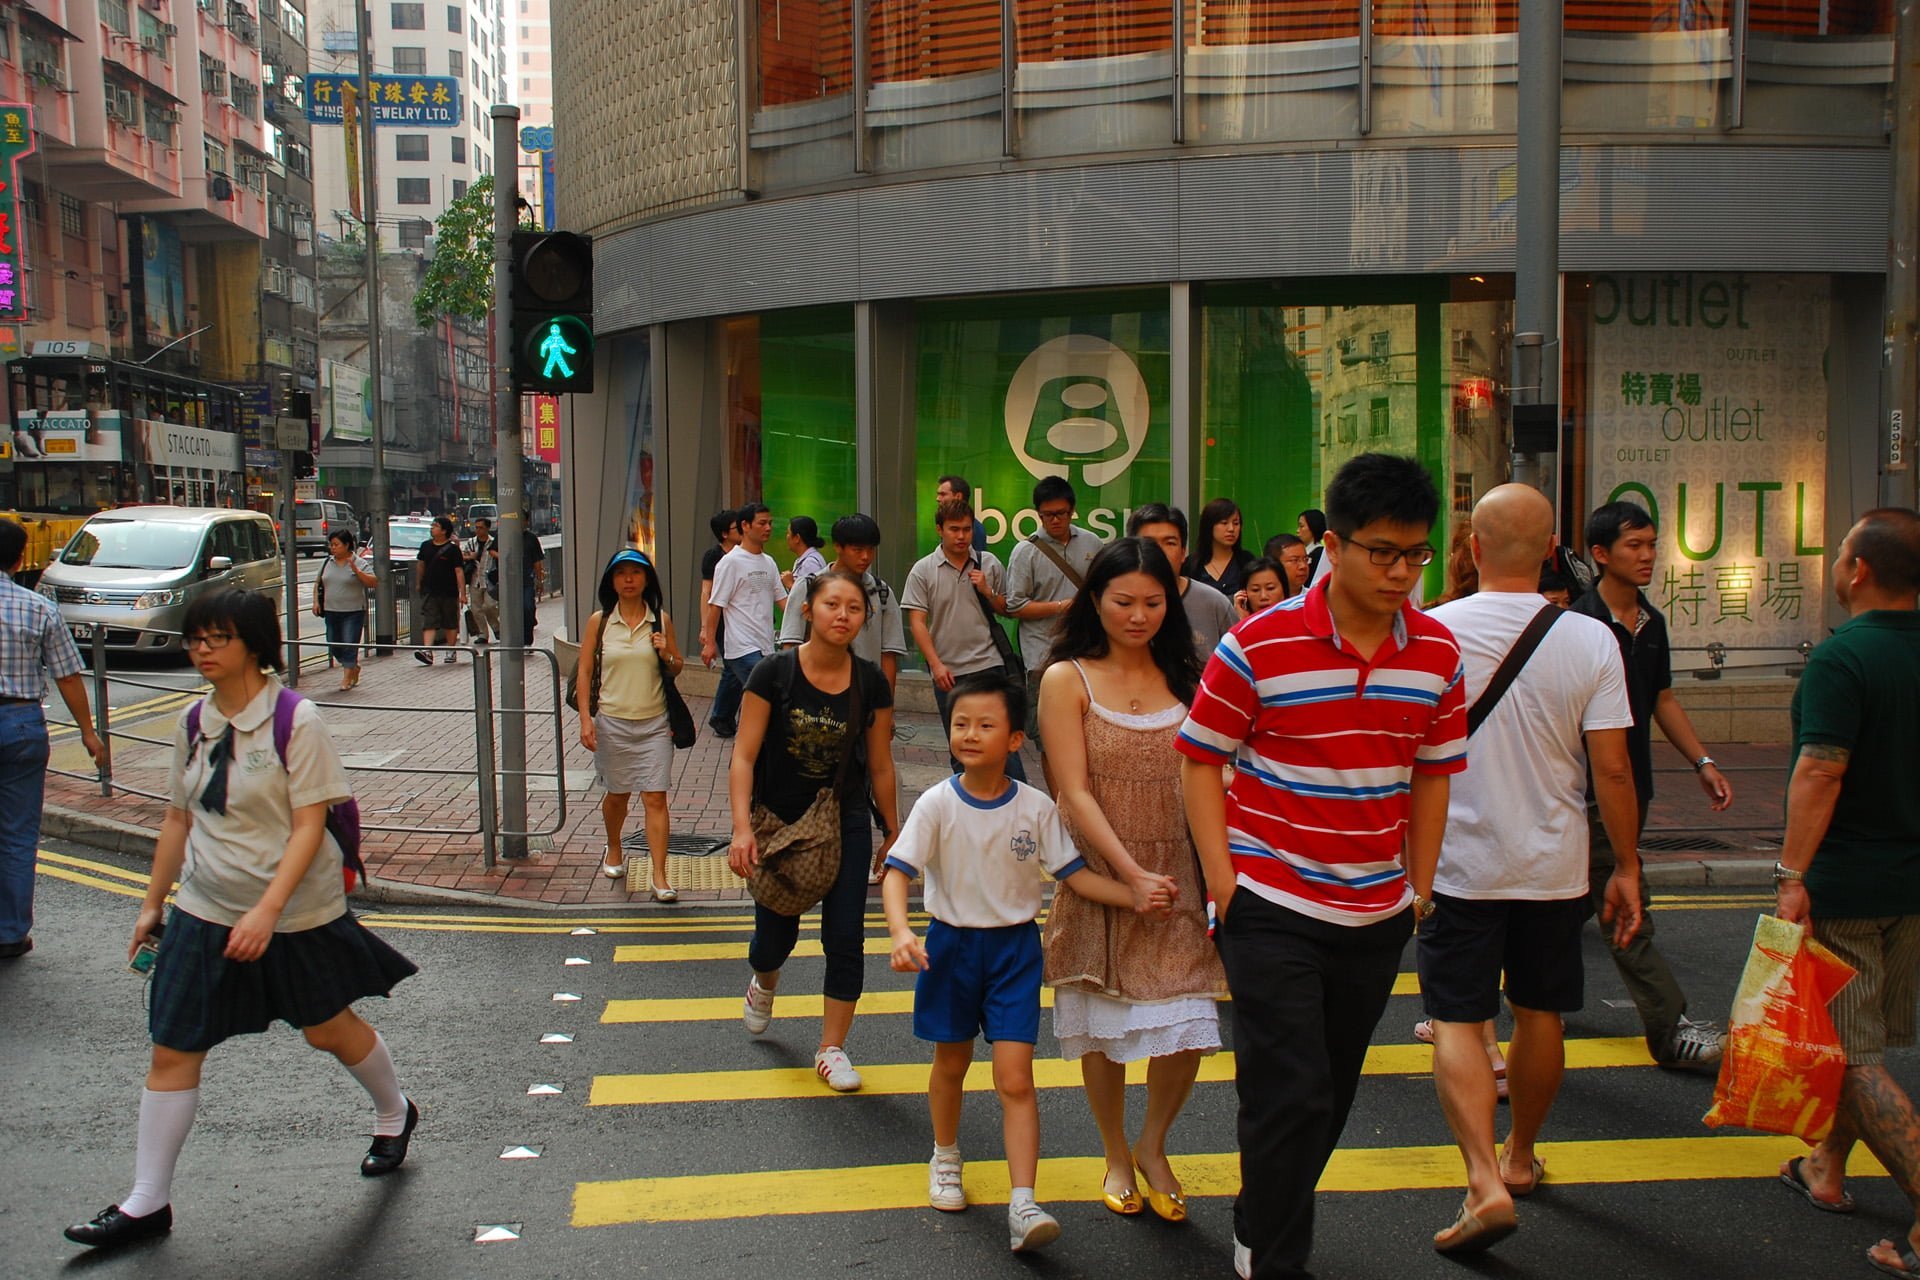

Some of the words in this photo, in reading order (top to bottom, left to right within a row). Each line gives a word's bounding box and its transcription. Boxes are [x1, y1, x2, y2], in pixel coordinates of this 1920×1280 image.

[376, 106, 421, 120] EWELRY
[425, 107, 451, 121] LTD.
[47, 341, 76, 354] 105
[1726, 348, 1776, 361] OUTLET
[11, 365, 23, 374] 105
[91, 365, 106, 374] 105
[1620, 371, 1702, 406] 特賣場
[29, 418, 92, 430] STACCATO
[1661, 395, 1764, 442] outlet
[1891, 412, 1901, 461] 25909
[168, 433, 211, 457] STACCATO
[1616, 448, 1670, 462] OUTLET
[1662, 562, 1803, 627] 特賣場
